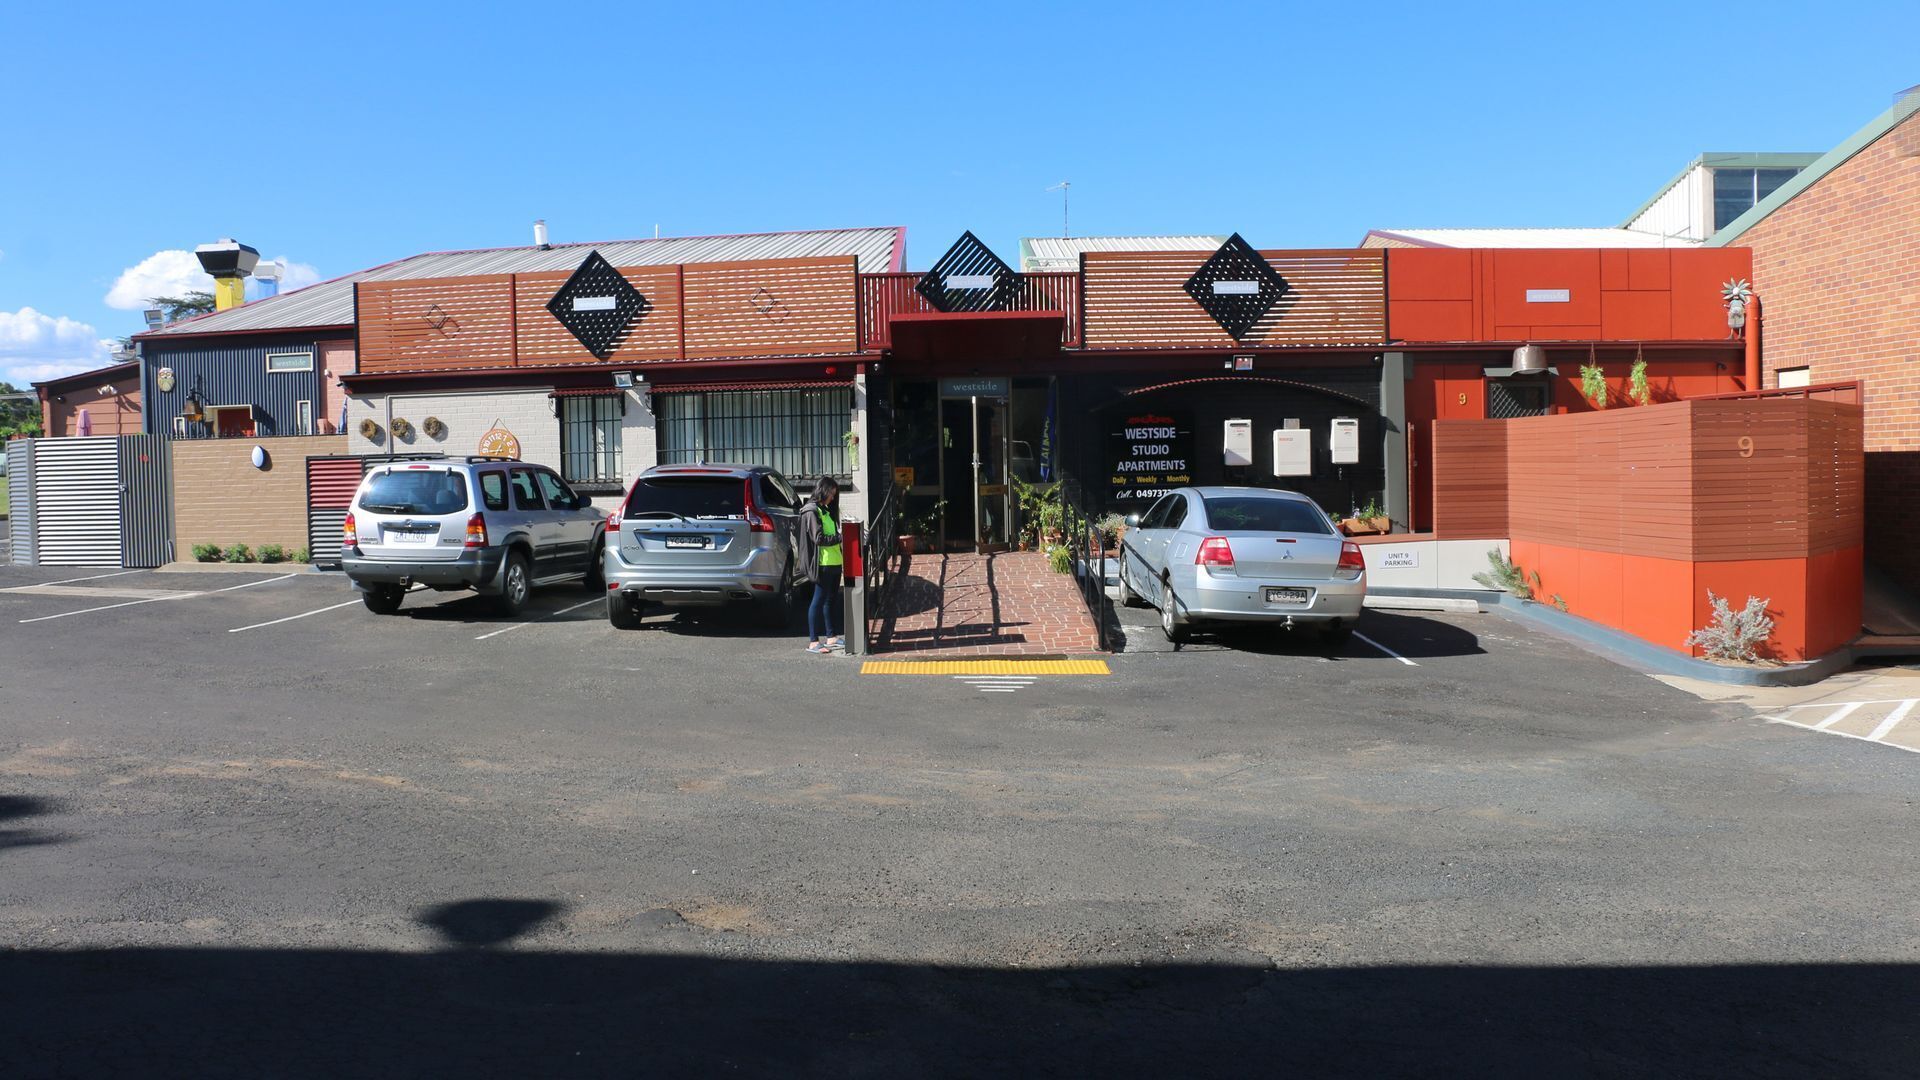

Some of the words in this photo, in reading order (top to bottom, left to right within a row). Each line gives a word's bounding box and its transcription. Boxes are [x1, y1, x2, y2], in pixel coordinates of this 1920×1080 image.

[952, 380, 998, 391] westside
[1458, 392, 1466, 404] 9
[1124, 427, 1176, 440] WESTSIDE
[1132, 444, 1170, 456] STUDIO
[1738, 436, 1754, 458] 9
[1117, 460, 1186, 472] APARTMENTS
[1112, 476, 1126, 485] Daily
[1136, 475, 1157, 484] Weekly
[1166, 474, 1190, 484] Monthly
